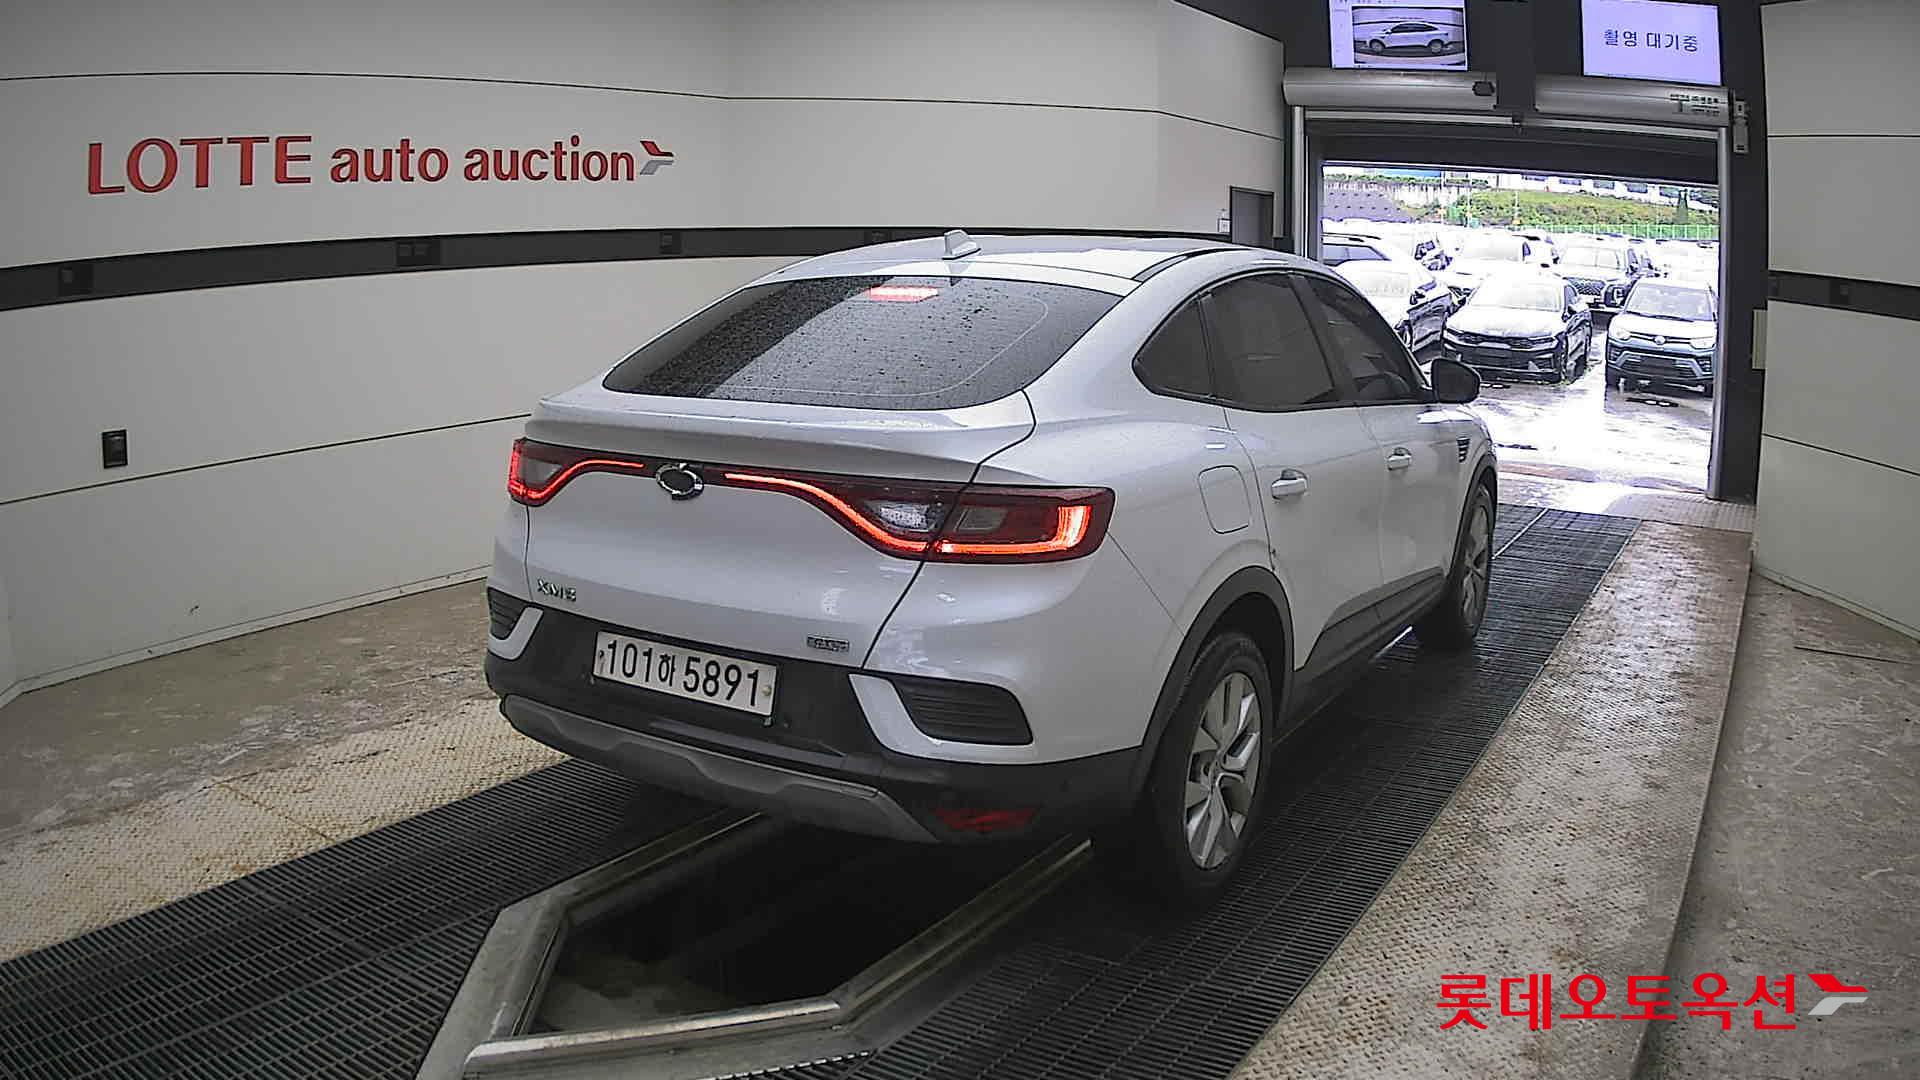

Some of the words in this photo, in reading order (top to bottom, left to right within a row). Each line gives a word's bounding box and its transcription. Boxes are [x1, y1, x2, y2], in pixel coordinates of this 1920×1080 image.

[1646, 32, 1698, 52] 대기중
[87, 135, 312, 195] LOTTE
[330, 138, 450, 183] auto
[463, 135, 636, 182] auction
[607, 640, 676, 687] 101하
[683, 656, 759, 707] 5891
